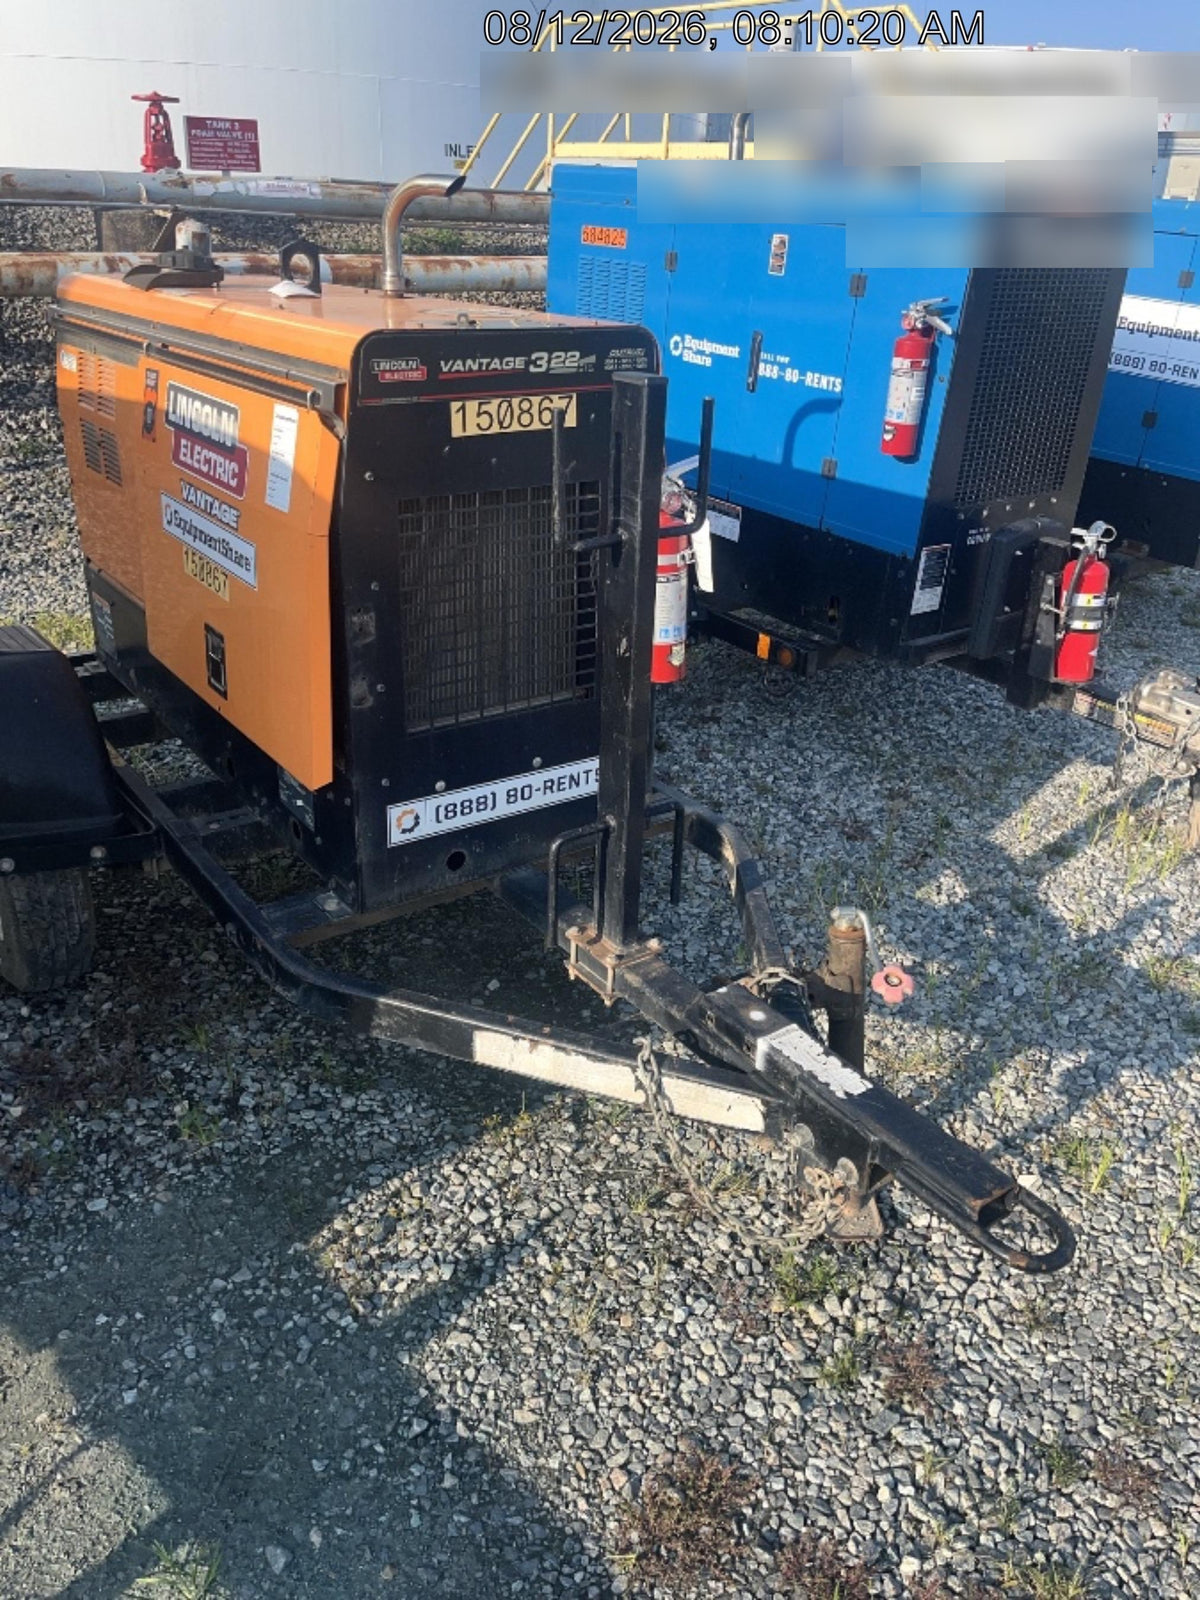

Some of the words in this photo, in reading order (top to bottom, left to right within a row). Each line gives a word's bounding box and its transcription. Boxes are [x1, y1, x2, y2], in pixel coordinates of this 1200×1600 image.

[683, 334, 741, 359] Equipment
[1116, 316, 1200, 343] Equipment
[371, 360, 417, 371] LINCOLN
[440, 357, 528, 374] VANTAGE
[529, 351, 581, 374] 322
[682, 349, 712, 367] Share
[167, 388, 236, 449] LINCOLN
[453, 395, 575, 433] 150867
[178, 437, 240, 489] ELECTRIC
[179, 478, 241, 531] VANTAGE
[172, 508, 254, 573] EquipmentShare
[183, 549, 230, 595] 150867
[434, 789, 498, 824] (888)
